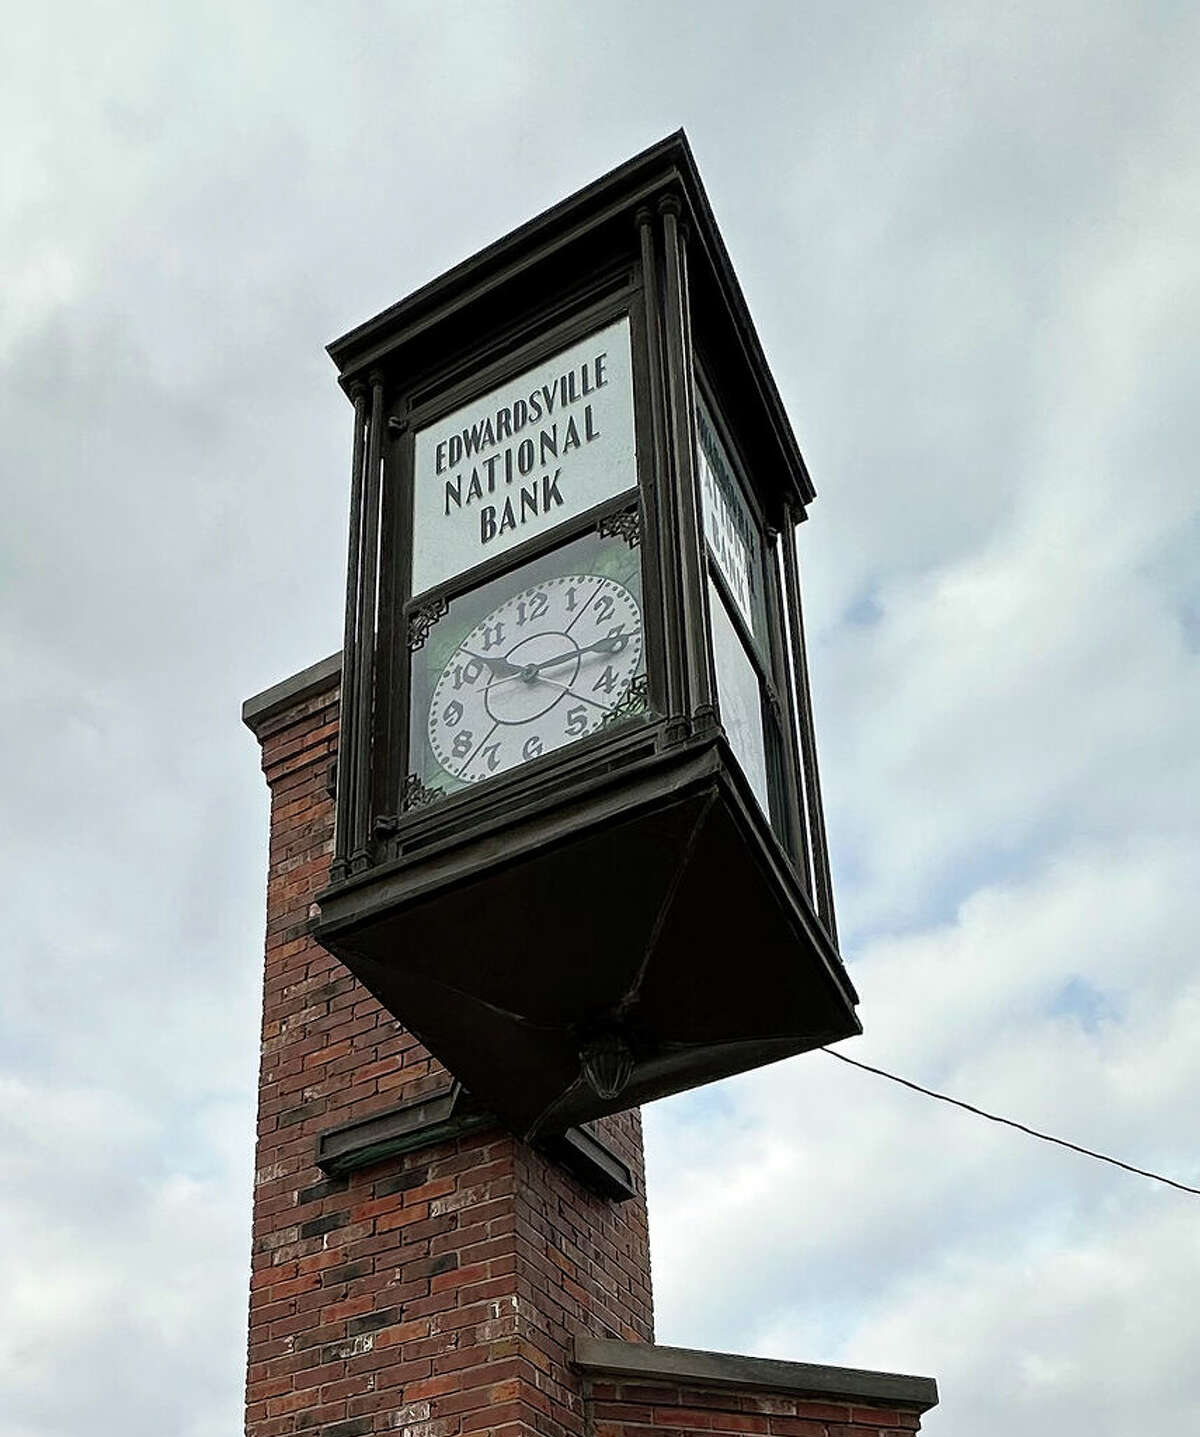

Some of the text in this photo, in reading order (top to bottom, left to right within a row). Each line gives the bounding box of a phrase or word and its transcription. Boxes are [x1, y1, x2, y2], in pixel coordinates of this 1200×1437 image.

[435, 352, 609, 477] EDWARDSVILLE
[444, 404, 601, 517] NATIONAL
[480, 467, 565, 545] BANK
[516, 591, 549, 627] 12
[564, 586, 579, 612] 1
[594, 595, 616, 625] 2
[481, 622, 506, 652] 11
[452, 656, 485, 691] 10
[592, 665, 620, 695] 4
[443, 699, 464, 728] 9
[564, 704, 588, 737] 5
[452, 729, 473, 759] 8
[481, 742, 502, 772] 7
[522, 735, 544, 761] 6
